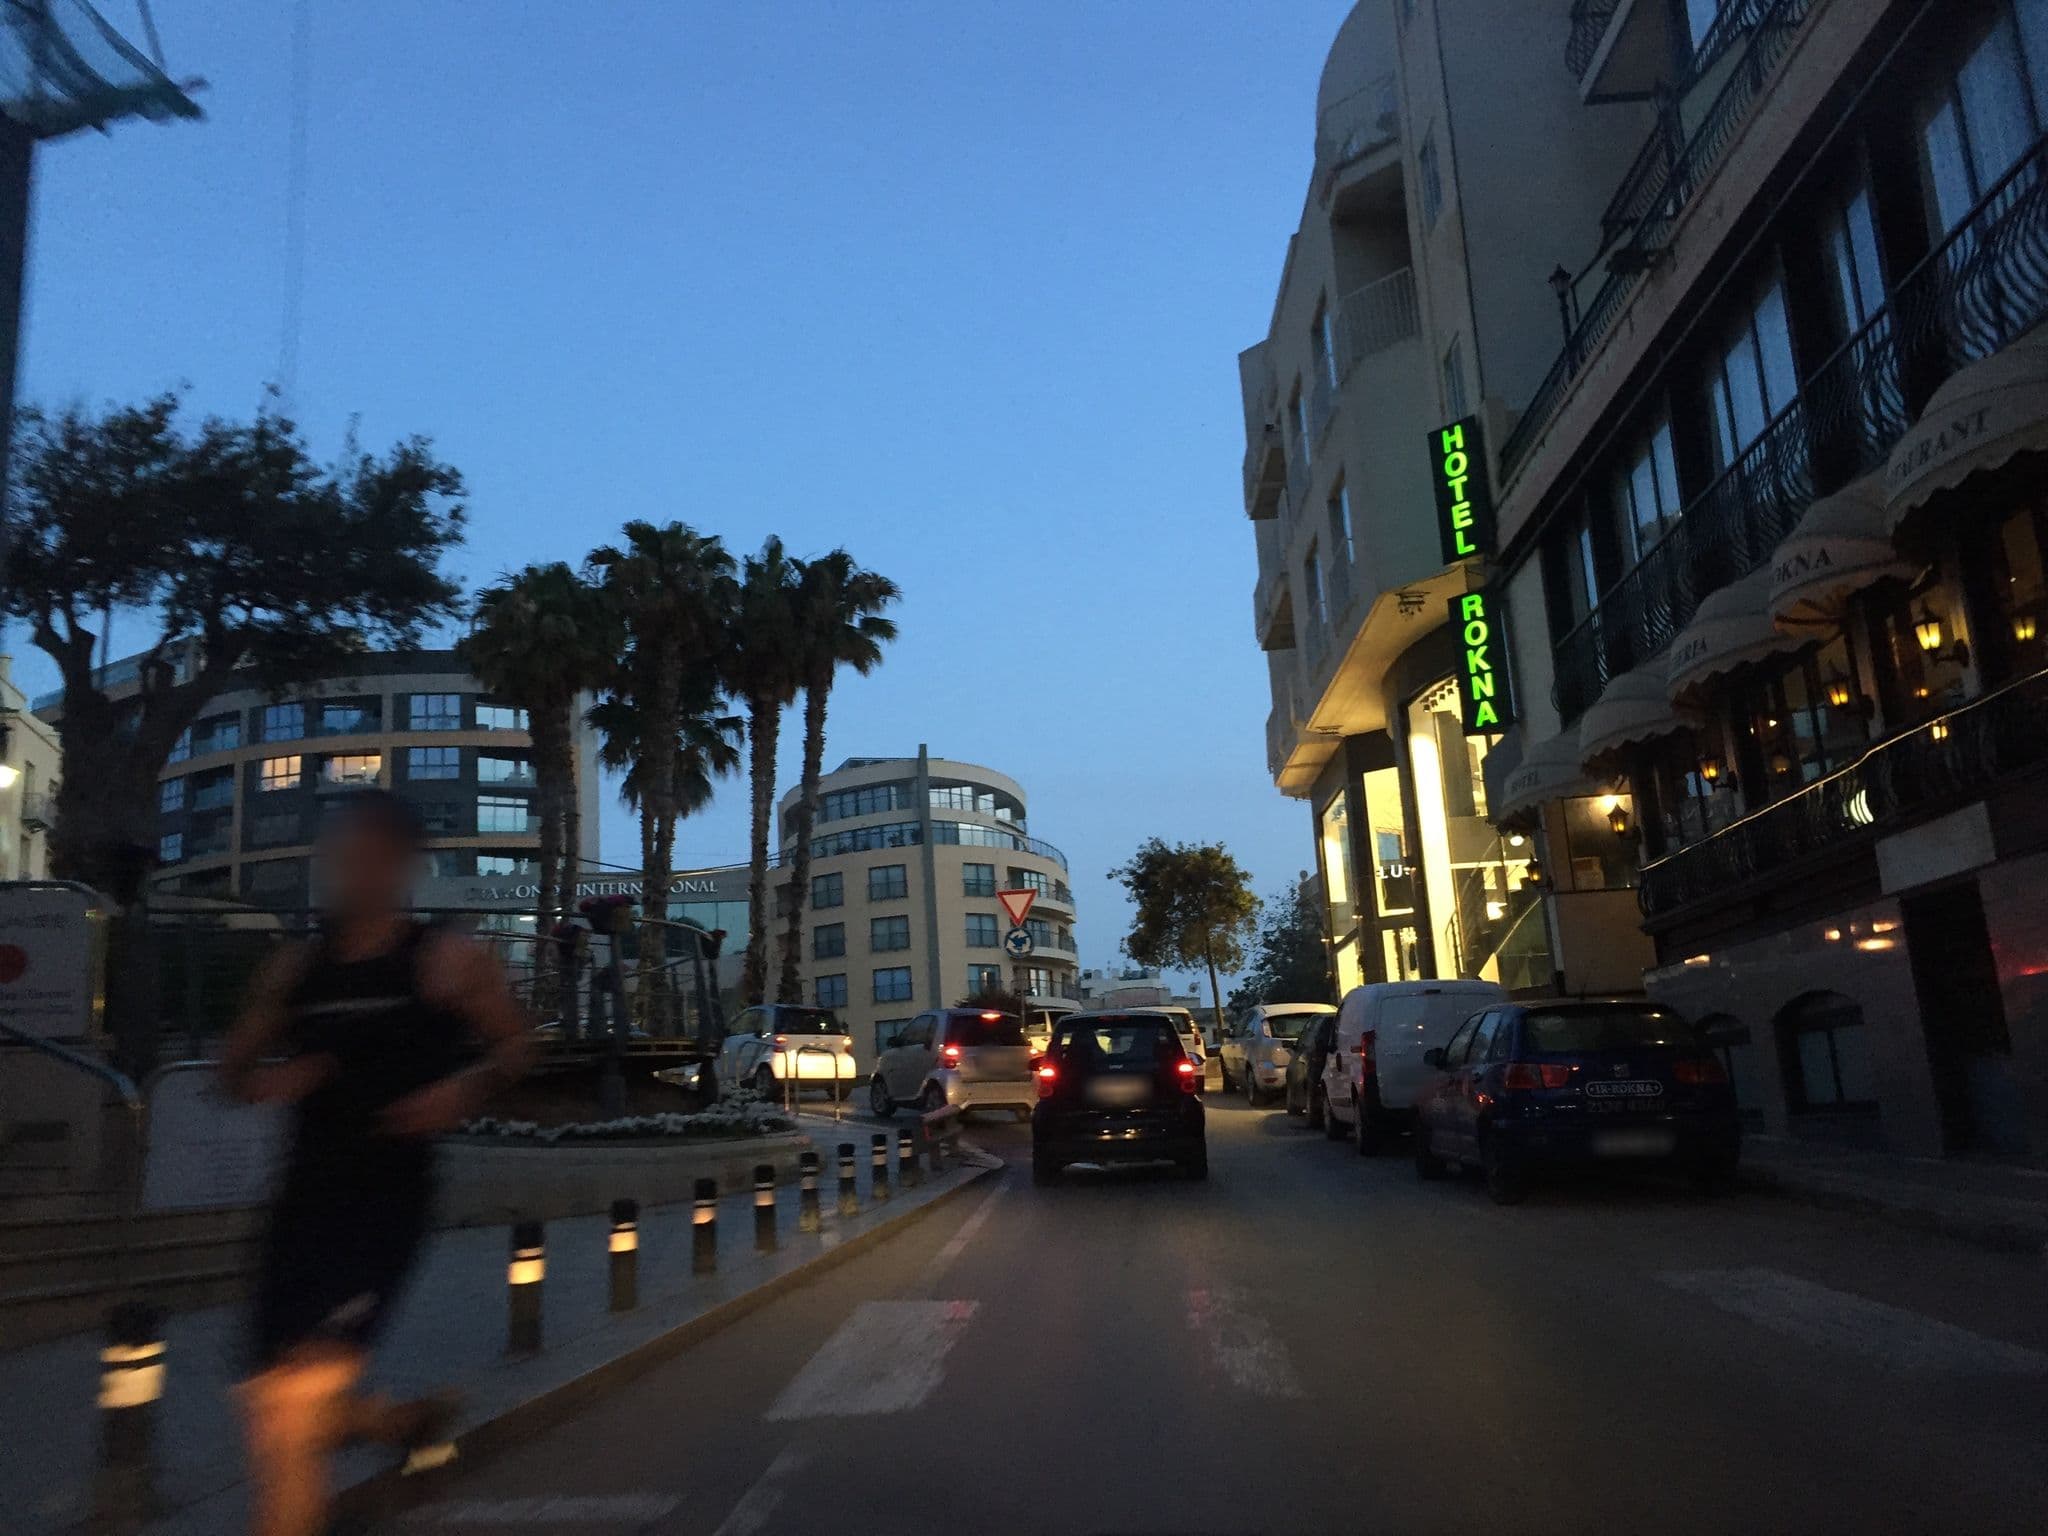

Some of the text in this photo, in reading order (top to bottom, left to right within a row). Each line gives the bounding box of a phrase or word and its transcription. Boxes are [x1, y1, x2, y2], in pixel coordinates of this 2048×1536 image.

[1441, 424, 1499, 728] HOTEL ROKNA
[576, 880, 718, 896] INTERNONAL
